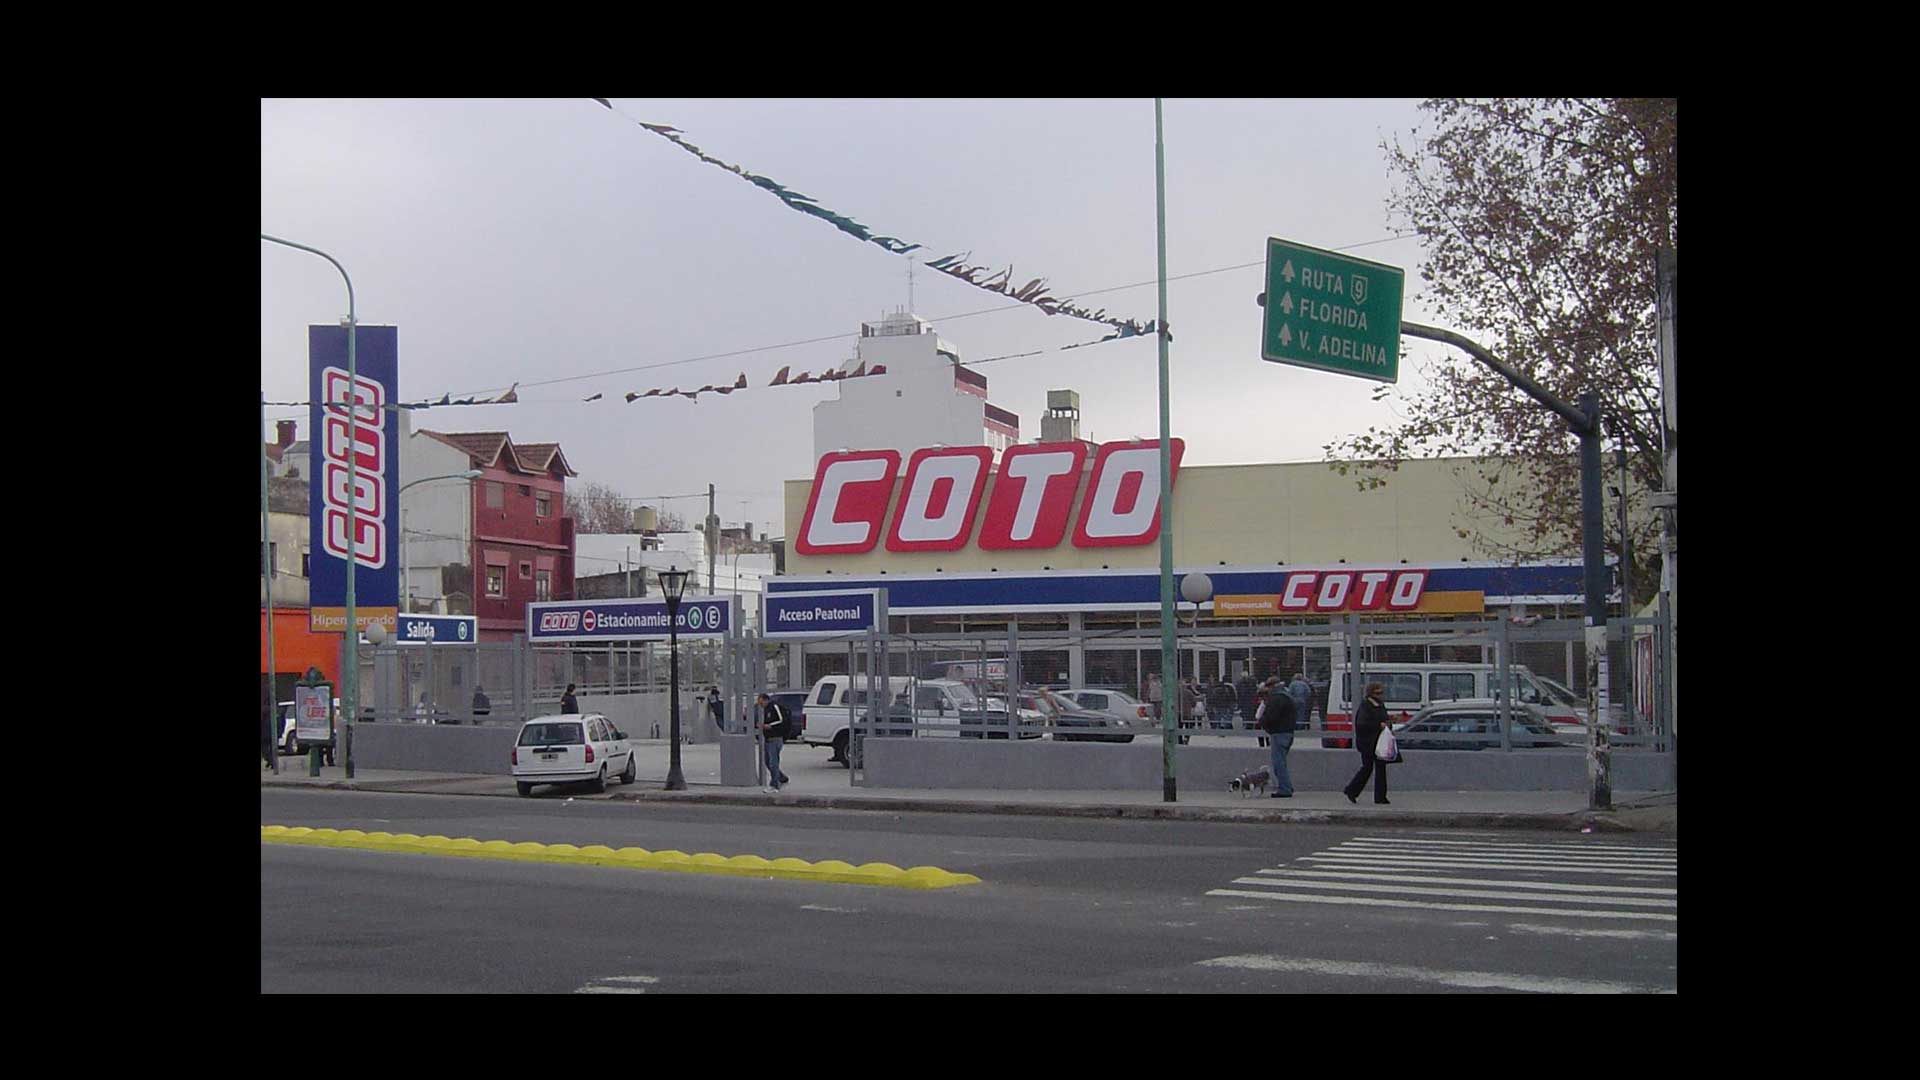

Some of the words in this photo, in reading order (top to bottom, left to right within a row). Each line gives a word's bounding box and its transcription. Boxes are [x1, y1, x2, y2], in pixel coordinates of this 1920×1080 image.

[1301, 267, 1344, 295] RUTA
[1354, 280, 1364, 299] 9
[1299, 297, 1368, 331] FLORIDA
[1298, 331, 1311, 351] V.
[1318, 335, 1387, 366] ADELINA
[328, 372, 381, 564] COTO
[806, 447, 1164, 547] COTO
[1281, 572, 1425, 608] COTO
[312, 613, 396, 627] Hiperercado
[406, 621, 435, 638] Salida
[541, 612, 580, 632] COTO
[778, 608, 813, 622] Acceso
[814, 605, 861, 621] Peatonal
